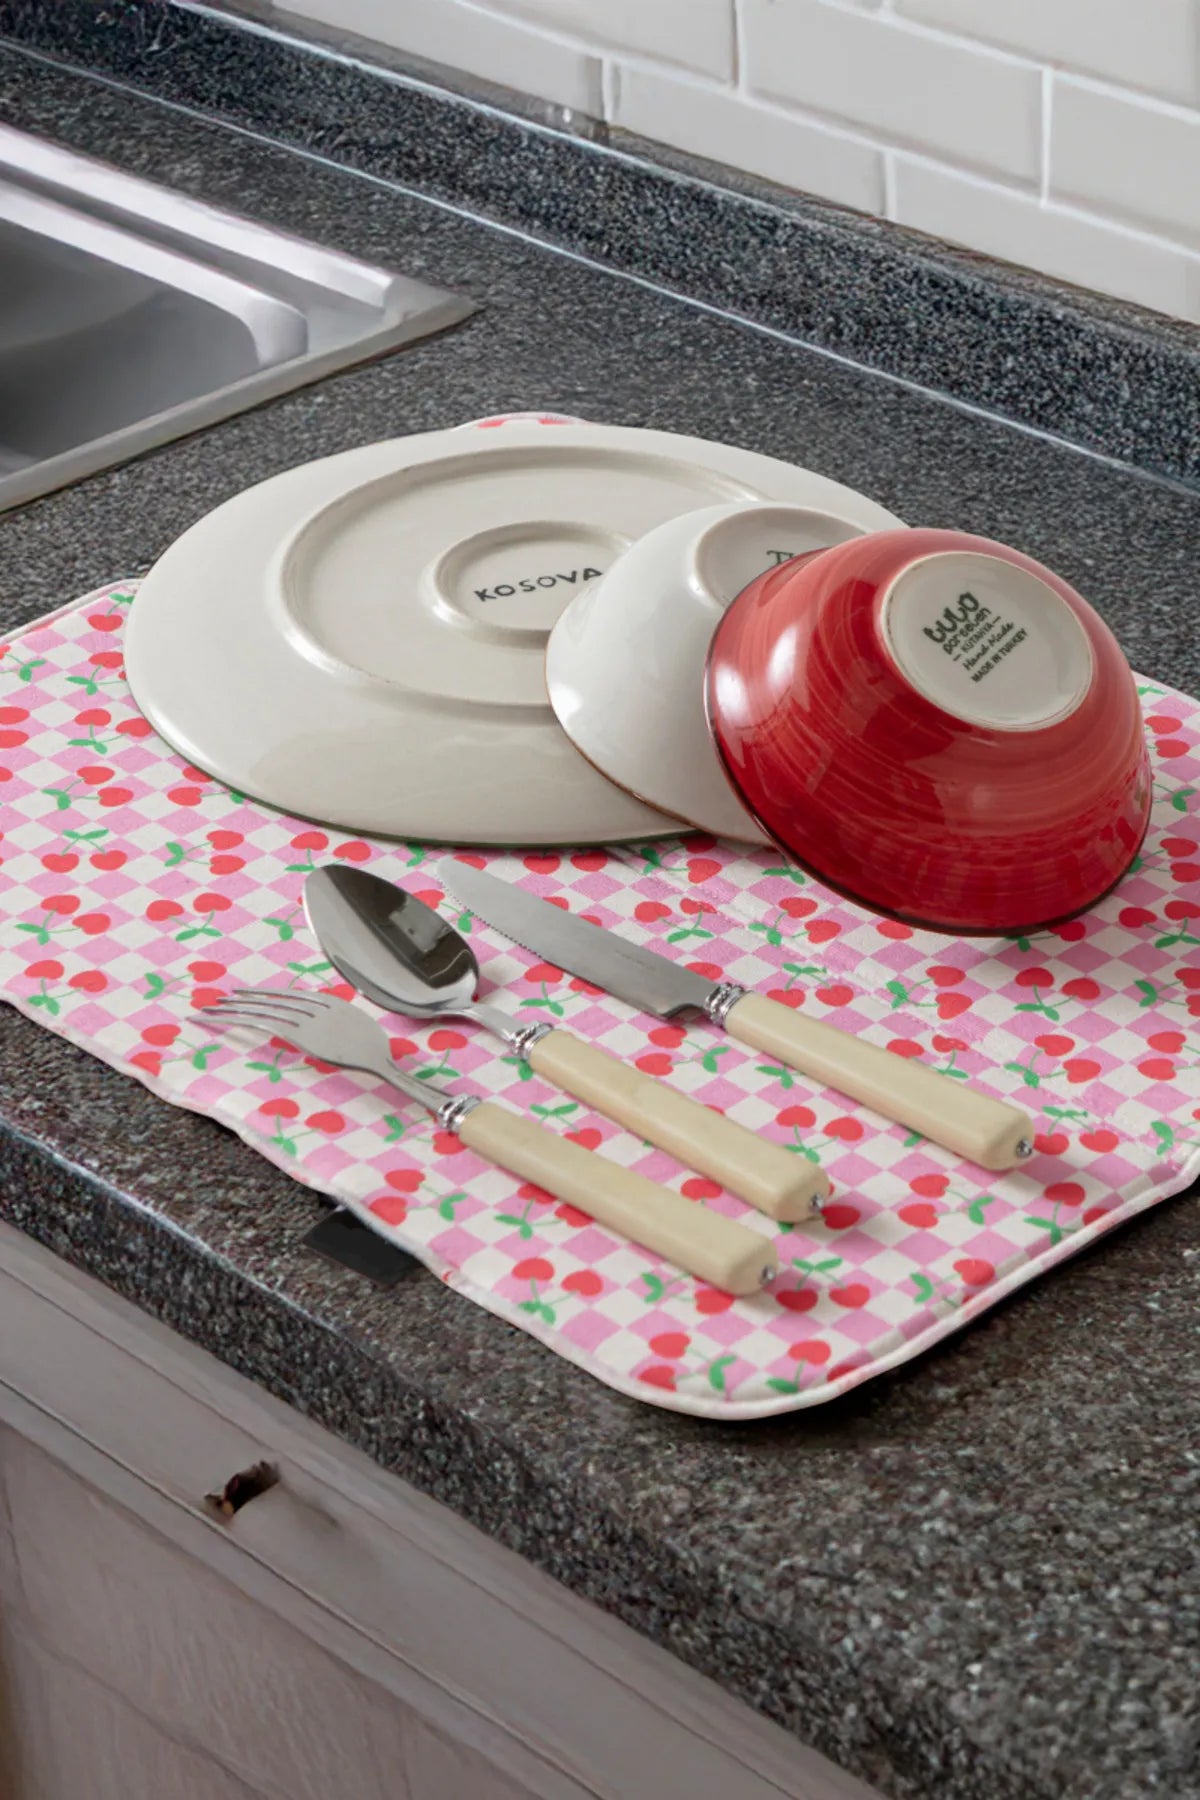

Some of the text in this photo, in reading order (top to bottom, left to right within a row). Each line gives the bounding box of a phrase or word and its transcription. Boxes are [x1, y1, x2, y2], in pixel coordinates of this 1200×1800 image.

[474, 567, 603, 602] KOSOVA
[962, 622, 1014, 671] Hand Made
[970, 627, 1028, 682] MADE IN TURKEY
